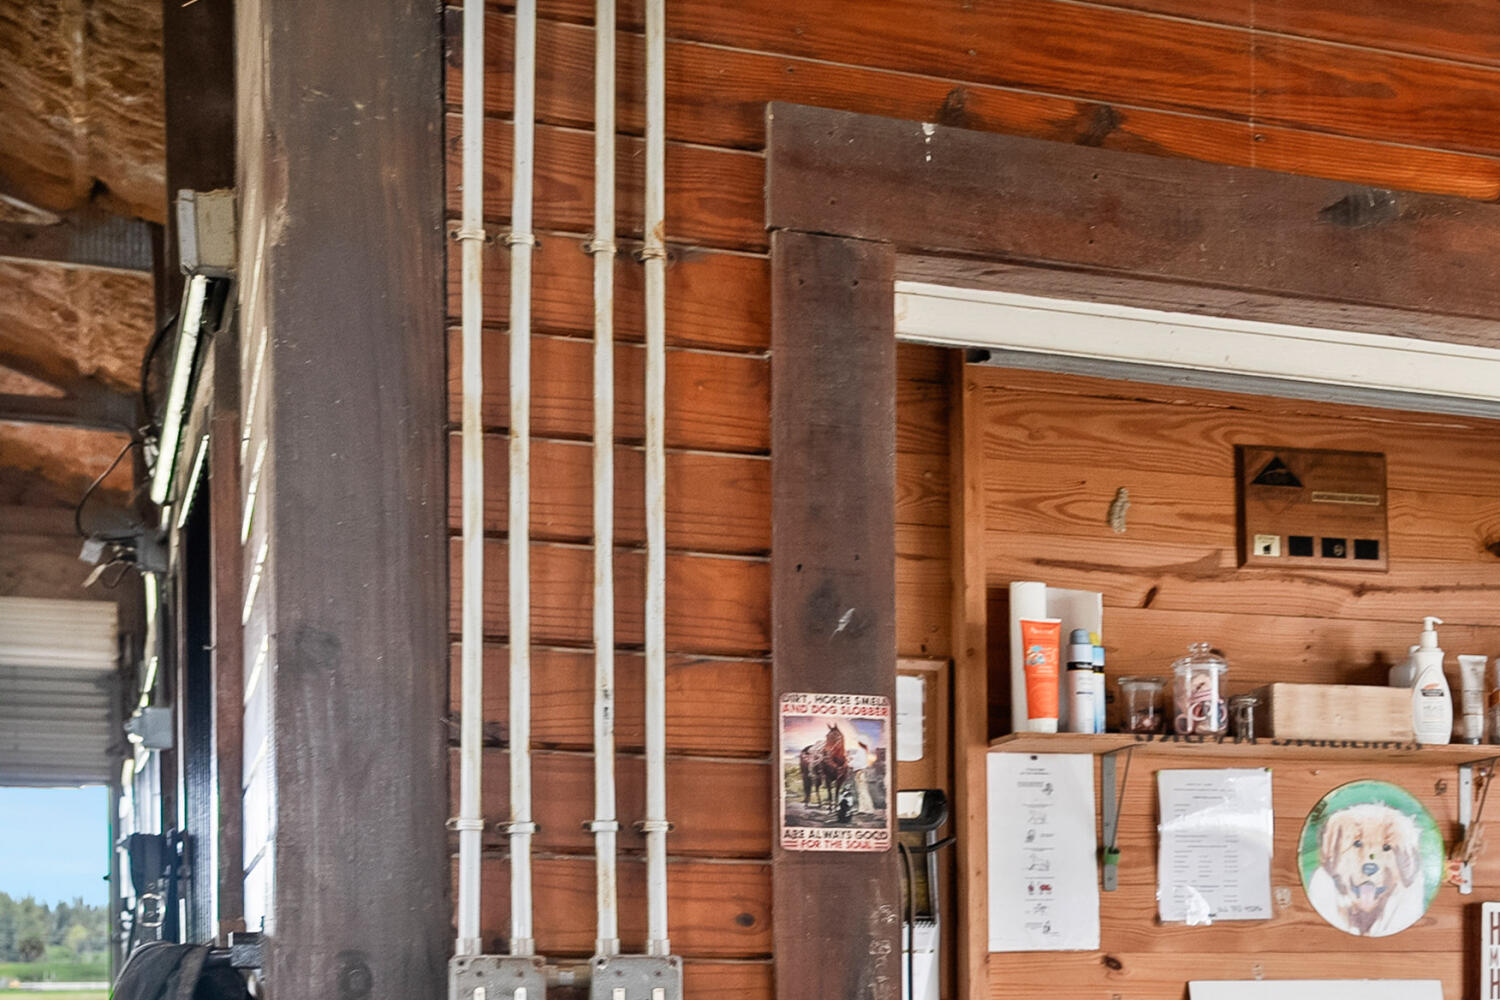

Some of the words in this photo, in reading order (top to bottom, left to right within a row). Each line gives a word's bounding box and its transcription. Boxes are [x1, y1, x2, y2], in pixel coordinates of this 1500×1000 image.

[814, 694, 851, 705] HORSE
[783, 703, 808, 713] AND
[811, 704, 838, 715] DOG
[840, 705, 889, 716] SLOBBER
[783, 828, 805, 839] ARE
[808, 829, 852, 840] ALWAYS
[855, 830, 889, 840] GOOD
[801, 839, 821, 849] FOR
[824, 839, 843, 849] THE
